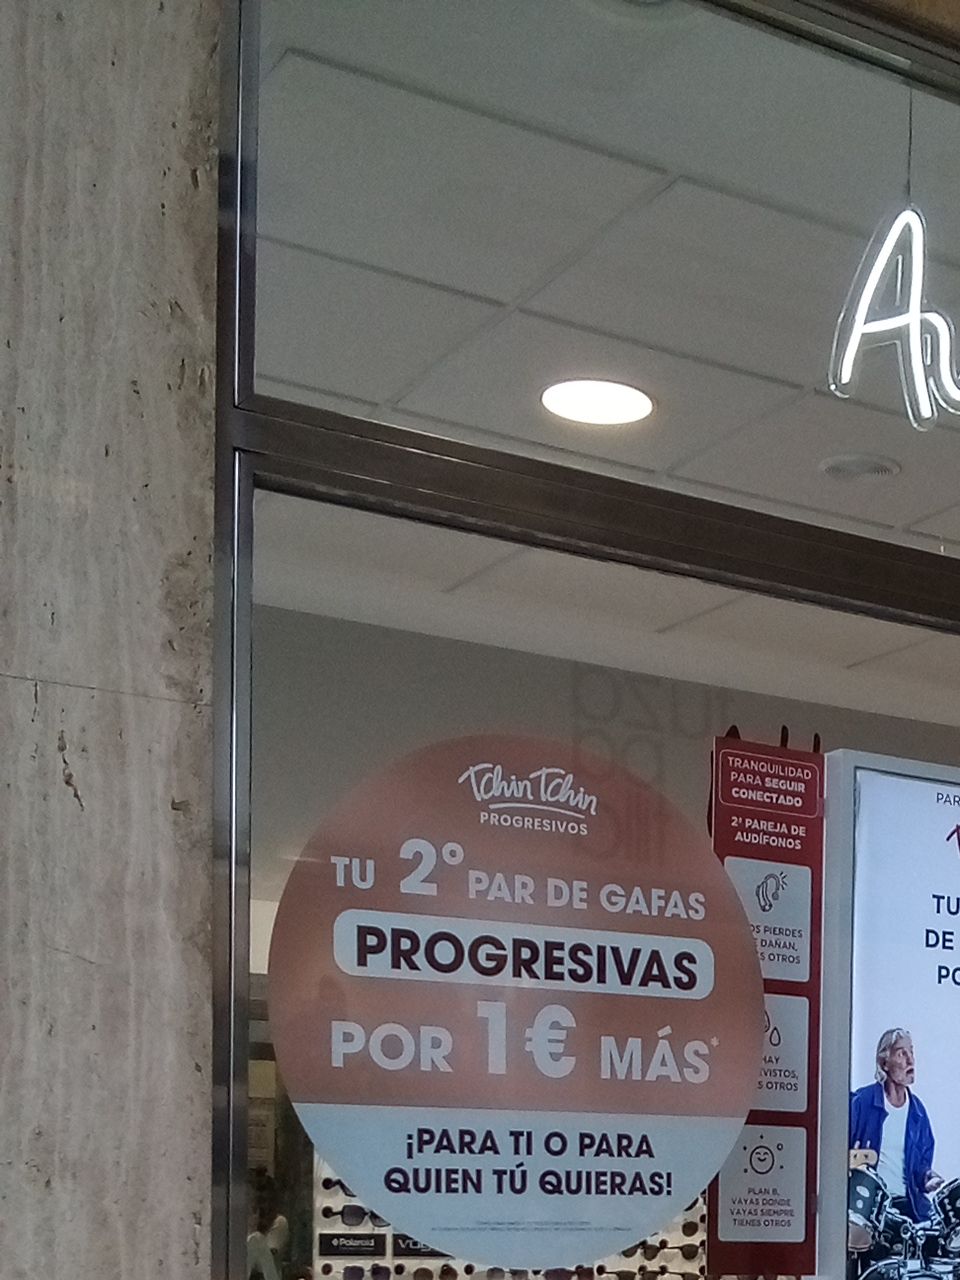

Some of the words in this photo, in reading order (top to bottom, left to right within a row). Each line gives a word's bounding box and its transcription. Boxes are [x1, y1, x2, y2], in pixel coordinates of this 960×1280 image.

[728, 756, 811, 780] TRANQUILIDAD
[458, 763, 532, 803] Tchin
[530, 766, 598, 815] Tchin
[731, 772, 762, 787] PARA
[765, 778, 806, 794] SEGUIR
[732, 786, 803, 808] CONECTADO
[479, 811, 588, 836] PROGRESIVOS
[745, 818, 788, 834] PAREJA
[791, 825, 806, 837] DE
[735, 830, 802, 850] AUDÍFONOS
[330, 855, 375, 890] TU
[467, 869, 535, 905] PAR
[546, 878, 589, 910] DE
[599, 883, 706, 920] GAFAS
[932, 893, 960, 916] TU
[763, 925, 803, 938] PIERDES
[925, 928, 954, 950] DE
[355, 924, 698, 990] PROGRESIVAS
[767, 952, 801, 964] OTROS
[330, 1020, 453, 1073] POR
[766, 1081, 799, 1092] OTROS
[406, 1128, 499, 1160] ¡PARA
[510, 1130, 533, 1156] TI
[544, 1132, 568, 1158] O
[578, 1134, 655, 1159] PARA
[383, 1168, 483, 1195] QUIEN
[493, 1164, 527, 1196] TÚ
[539, 1170, 673, 1197] QUIERAS!
[730, 1208, 759, 1216] VAYAS
[731, 1198, 760, 1206] VAYAS
[763, 1219, 792, 1227] OTROS
[339, 1238, 375, 1248] Polaroid
